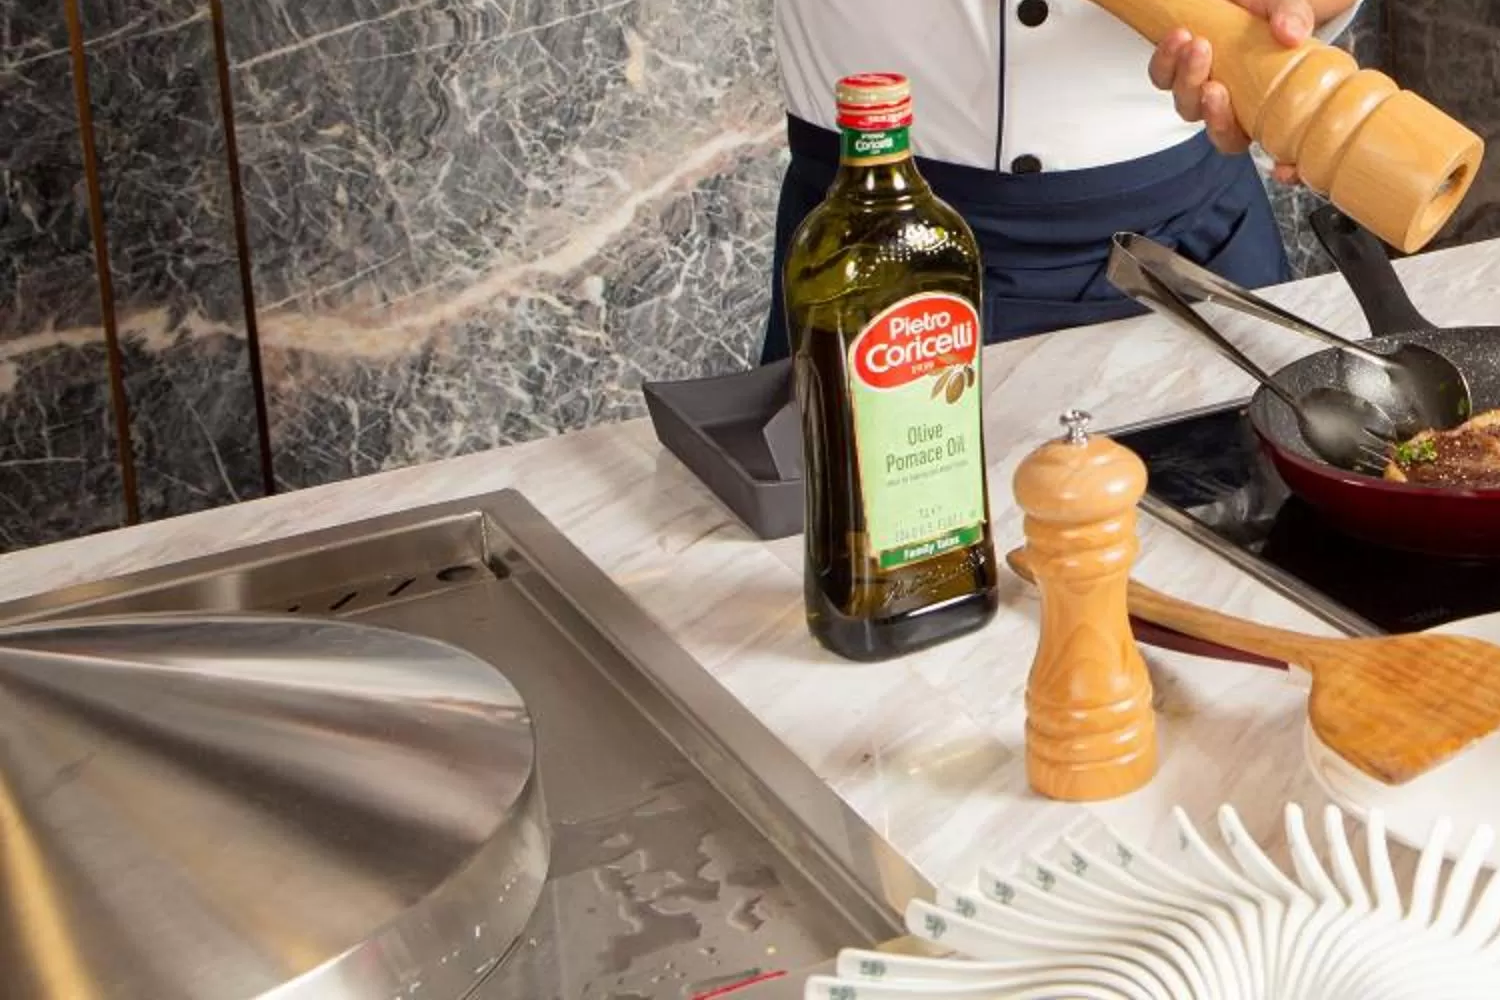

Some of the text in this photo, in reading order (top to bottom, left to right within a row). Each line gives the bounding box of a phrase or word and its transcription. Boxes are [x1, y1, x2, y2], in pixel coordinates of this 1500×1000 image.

[889, 311, 951, 340] Pietro
[865, 321, 973, 373] Coricelli
[907, 423, 943, 446] Olive
[886, 446, 943, 473] Pomace
[947, 435, 965, 457] Oil
